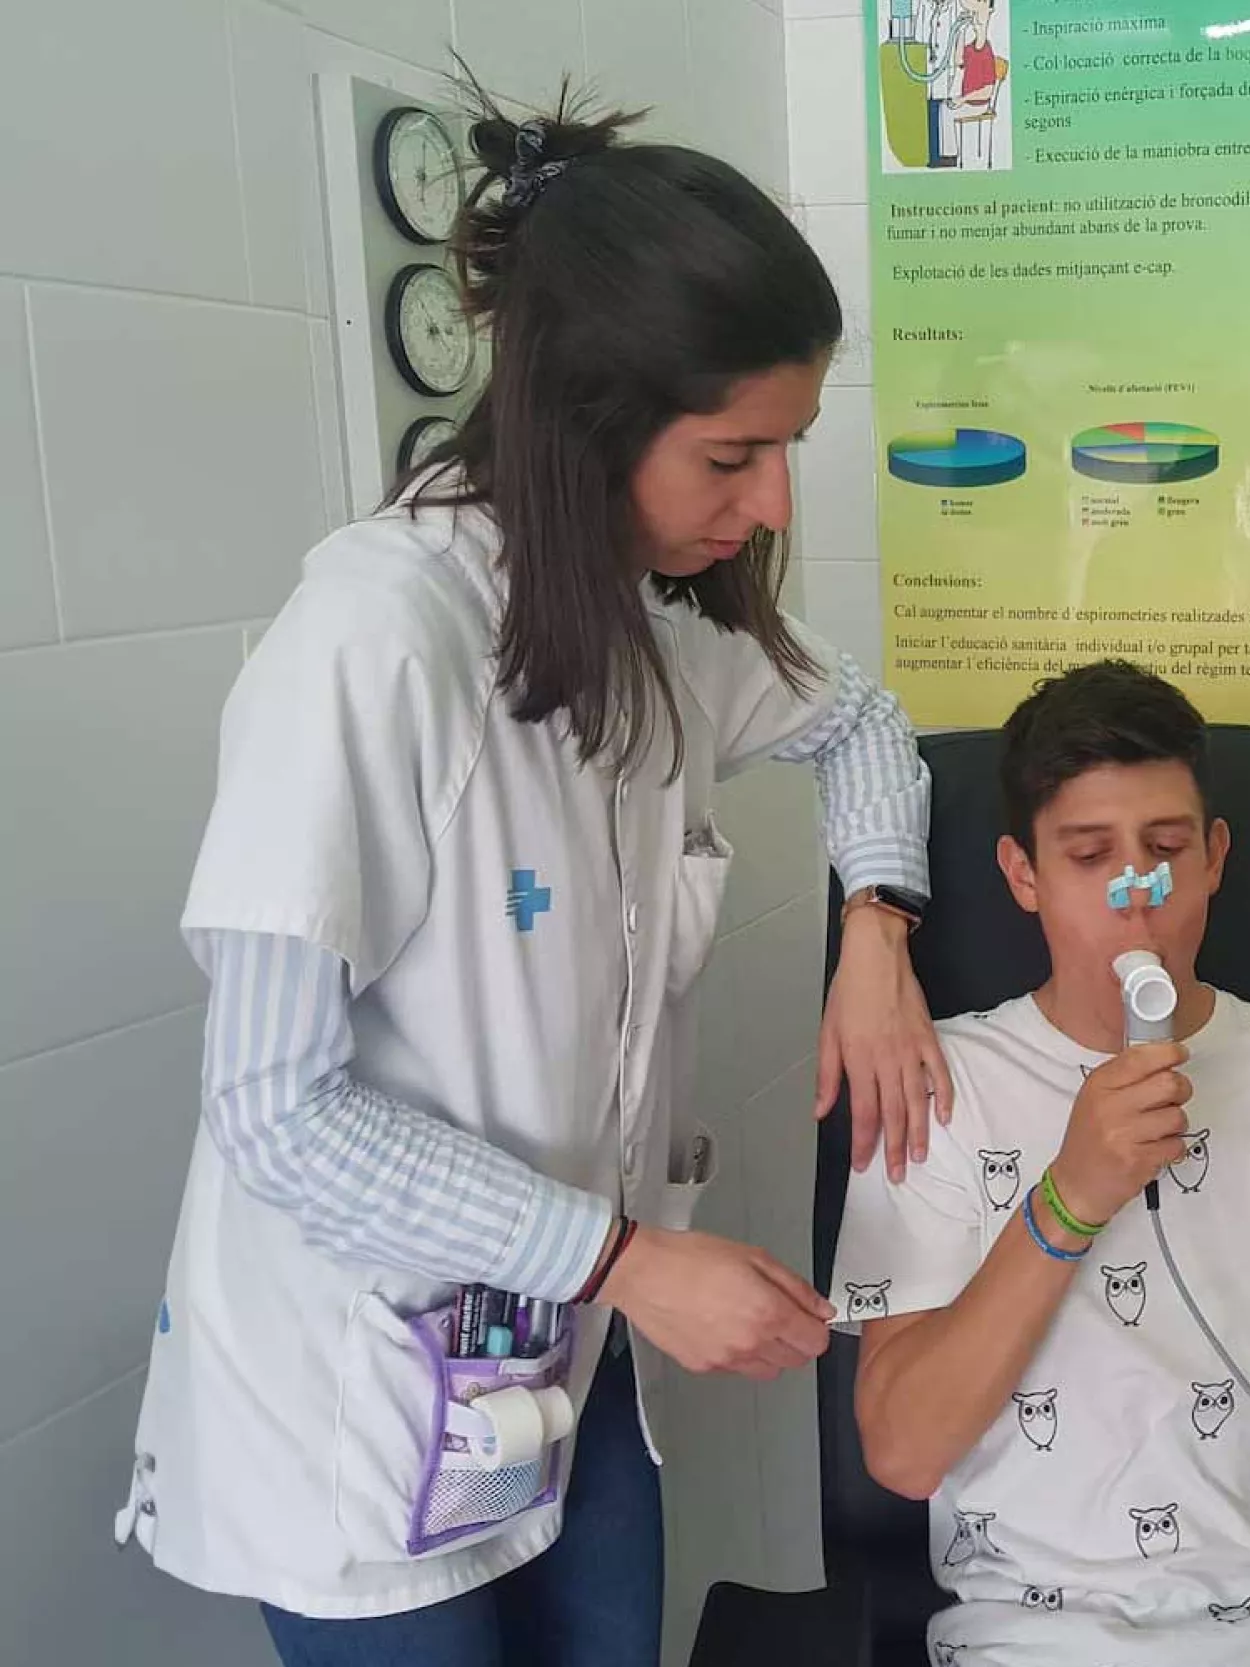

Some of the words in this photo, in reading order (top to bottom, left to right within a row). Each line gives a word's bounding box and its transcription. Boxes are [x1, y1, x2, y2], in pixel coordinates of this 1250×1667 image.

[1032, 17, 1103, 39] Inspiració
[1123, 51, 1181, 66] correcta
[1185, 47, 1203, 63] de
[1208, 46, 1220, 61] la
[1034, 87, 1100, 109] Espiració
[1180, 82, 1233, 100] forçada
[1024, 115, 1072, 132] segons
[1035, 146, 1100, 163] Execució
[1104, 145, 1121, 160] de
[1126, 144, 1138, 159] la
[1143, 142, 1210, 158] maniobra
[1214, 143, 1250, 156] entre
[891, 203, 979, 218] Instruccions
[984, 201, 996, 215] al
[1063, 201, 1081, 213] no
[1085, 194, 1156, 211] utilització
[1160, 192, 1177, 208] de
[887, 224, 926, 240] fumar
[940, 227, 957, 239] no
[962, 223, 1008, 241] menjar
[1012, 220, 1075, 236] abundant
[1080, 219, 1120, 234] abans
[1123, 217, 1141, 232] de
[1145, 216, 1158, 232] la
[893, 264, 965, 284] Explotació
[969, 263, 985, 278] de
[990, 262, 1009, 277] les
[1013, 262, 1051, 277] dades
[1056, 261, 1130, 280] mitjançant
[892, 326, 964, 342] Resultats:
[892, 573, 984, 589] Conclusions:
[893, 604, 916, 618] Cal
[919, 606, 989, 622] augmentar
[992, 606, 1004, 619] el
[1008, 606, 1059, 621] nombre
[1171, 608, 1245, 623] realitzades
[894, 634, 938, 649] Iniciar
[1076, 637, 1143, 653] individual
[1148, 639, 1166, 653] i/o
[1169, 640, 1213, 657] grupal
[1218, 643, 1240, 658] per
[895, 656, 963, 671] augmentar
[1043, 657, 1064, 673] del
[1171, 660, 1192, 675] del
[1196, 661, 1236, 678] règim
